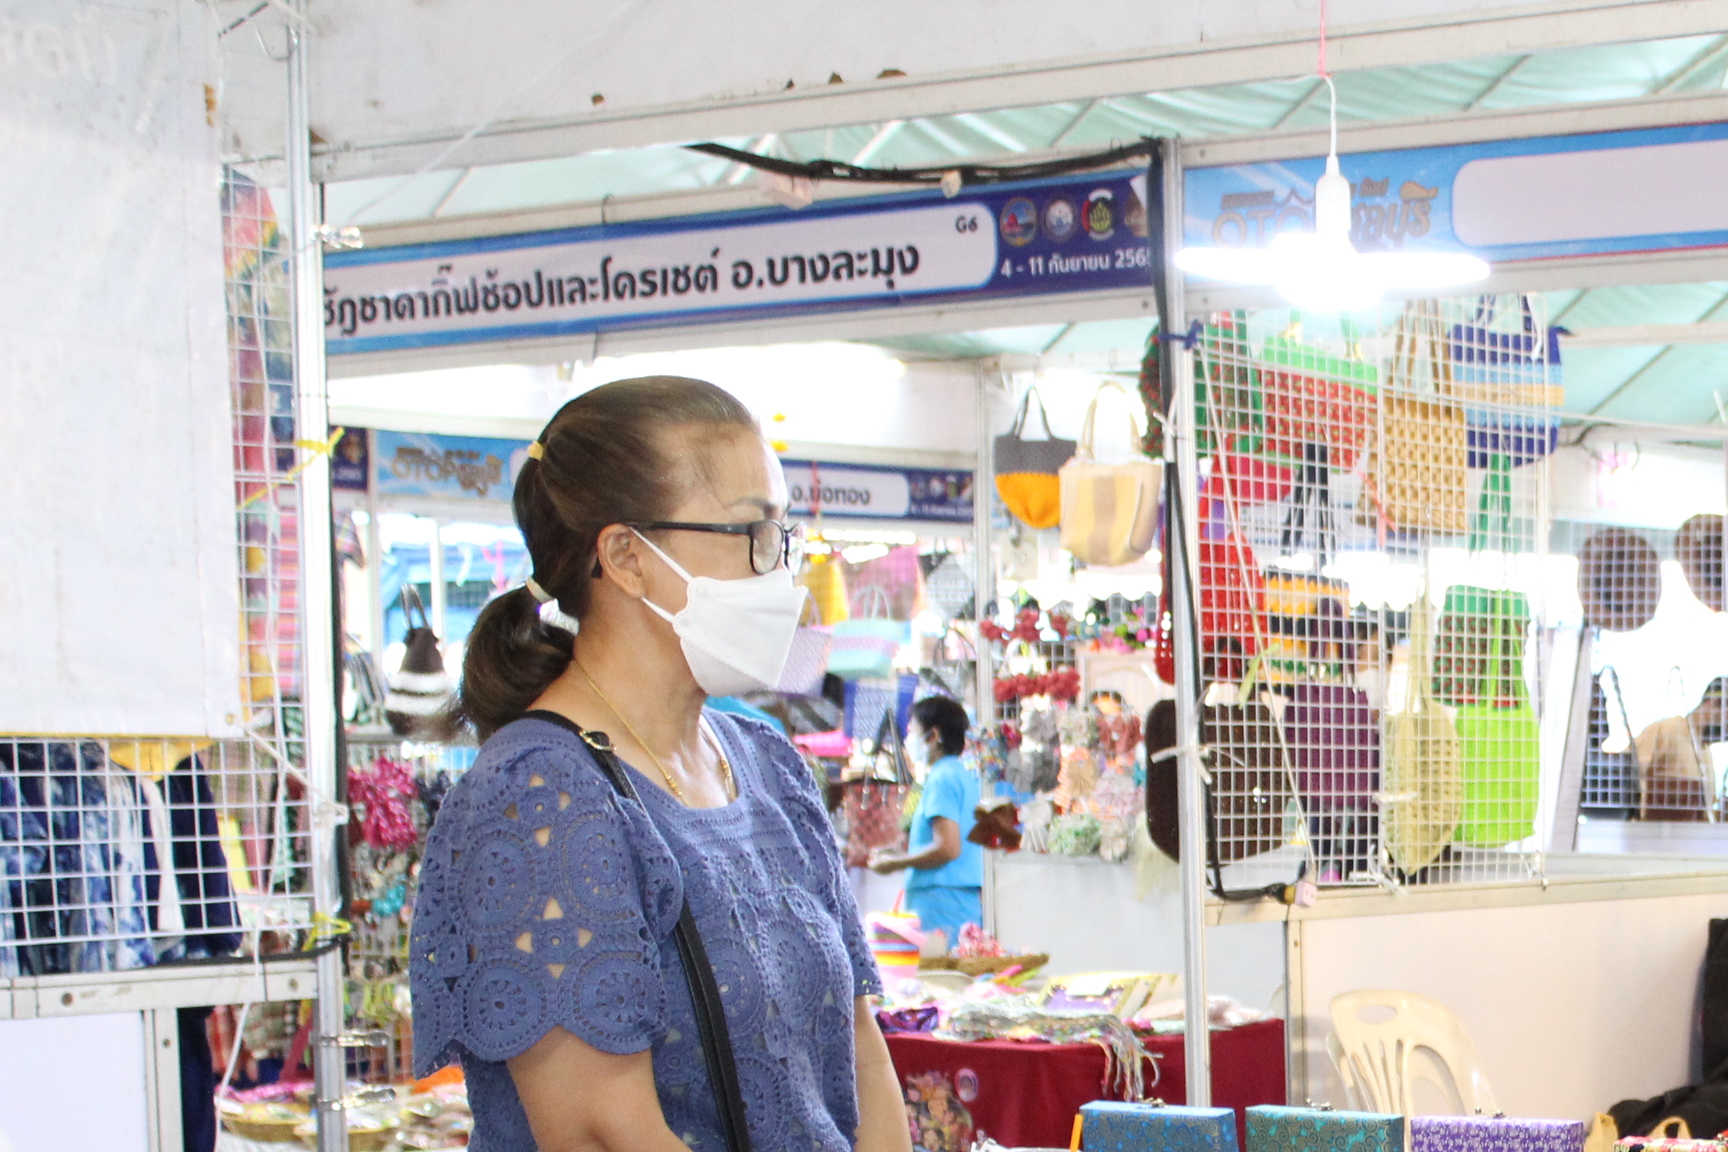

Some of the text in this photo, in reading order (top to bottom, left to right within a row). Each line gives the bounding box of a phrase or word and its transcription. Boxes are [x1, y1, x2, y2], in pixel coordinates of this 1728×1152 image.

[955, 214, 979, 234] G6
[731, 243, 920, 290] อ.บางละมุง
[1000, 257, 1012, 278] 4
[1028, 255, 1044, 276] 11
[1048, 252, 1110, 275] กันยายน
